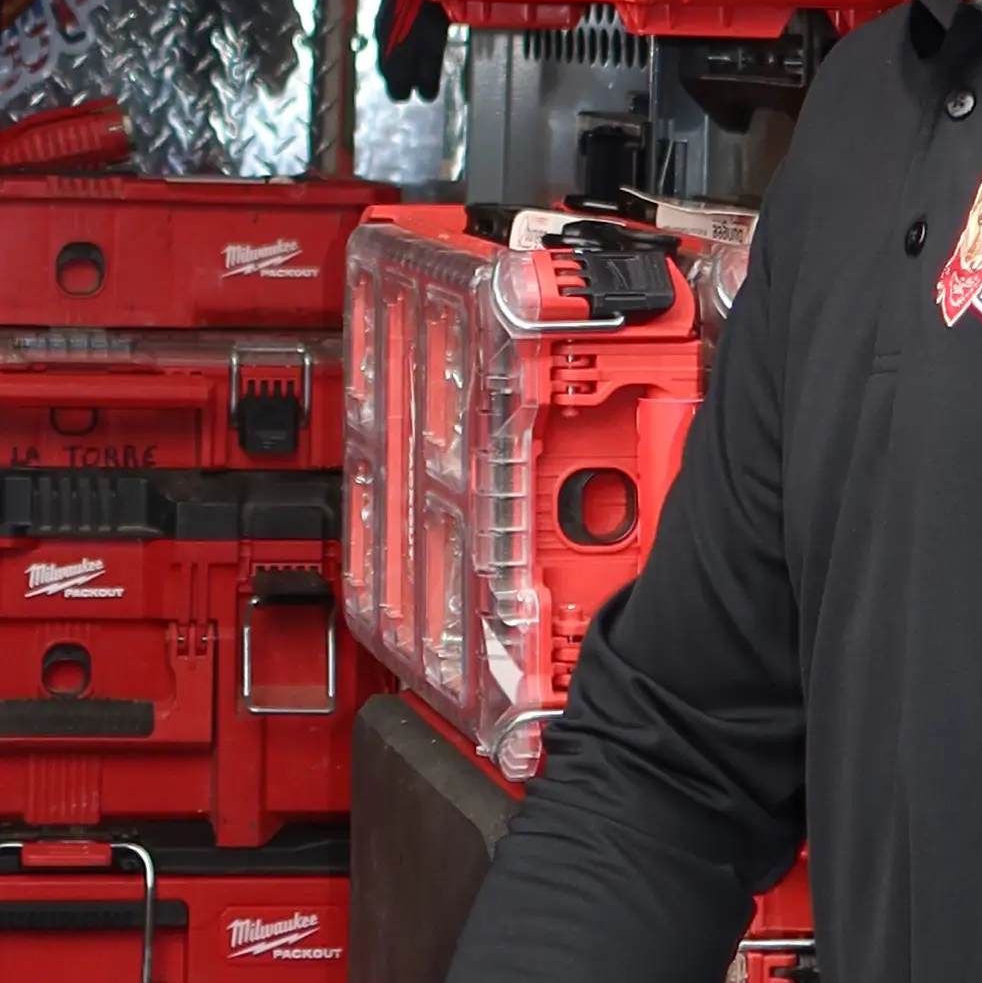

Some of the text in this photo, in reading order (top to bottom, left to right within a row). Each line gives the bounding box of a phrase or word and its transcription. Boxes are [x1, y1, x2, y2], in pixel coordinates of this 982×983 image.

[221, 238, 301, 269] Milwaukee
[260, 268, 319, 278] PACKOUT
[11, 444, 157, 468] LA TORRE
[24, 557, 105, 589] Milwaukee
[64, 587, 125, 598] PACKOUT
[226, 911, 320, 948] Milwaukee
[272, 947, 343, 959] PACKOUT
